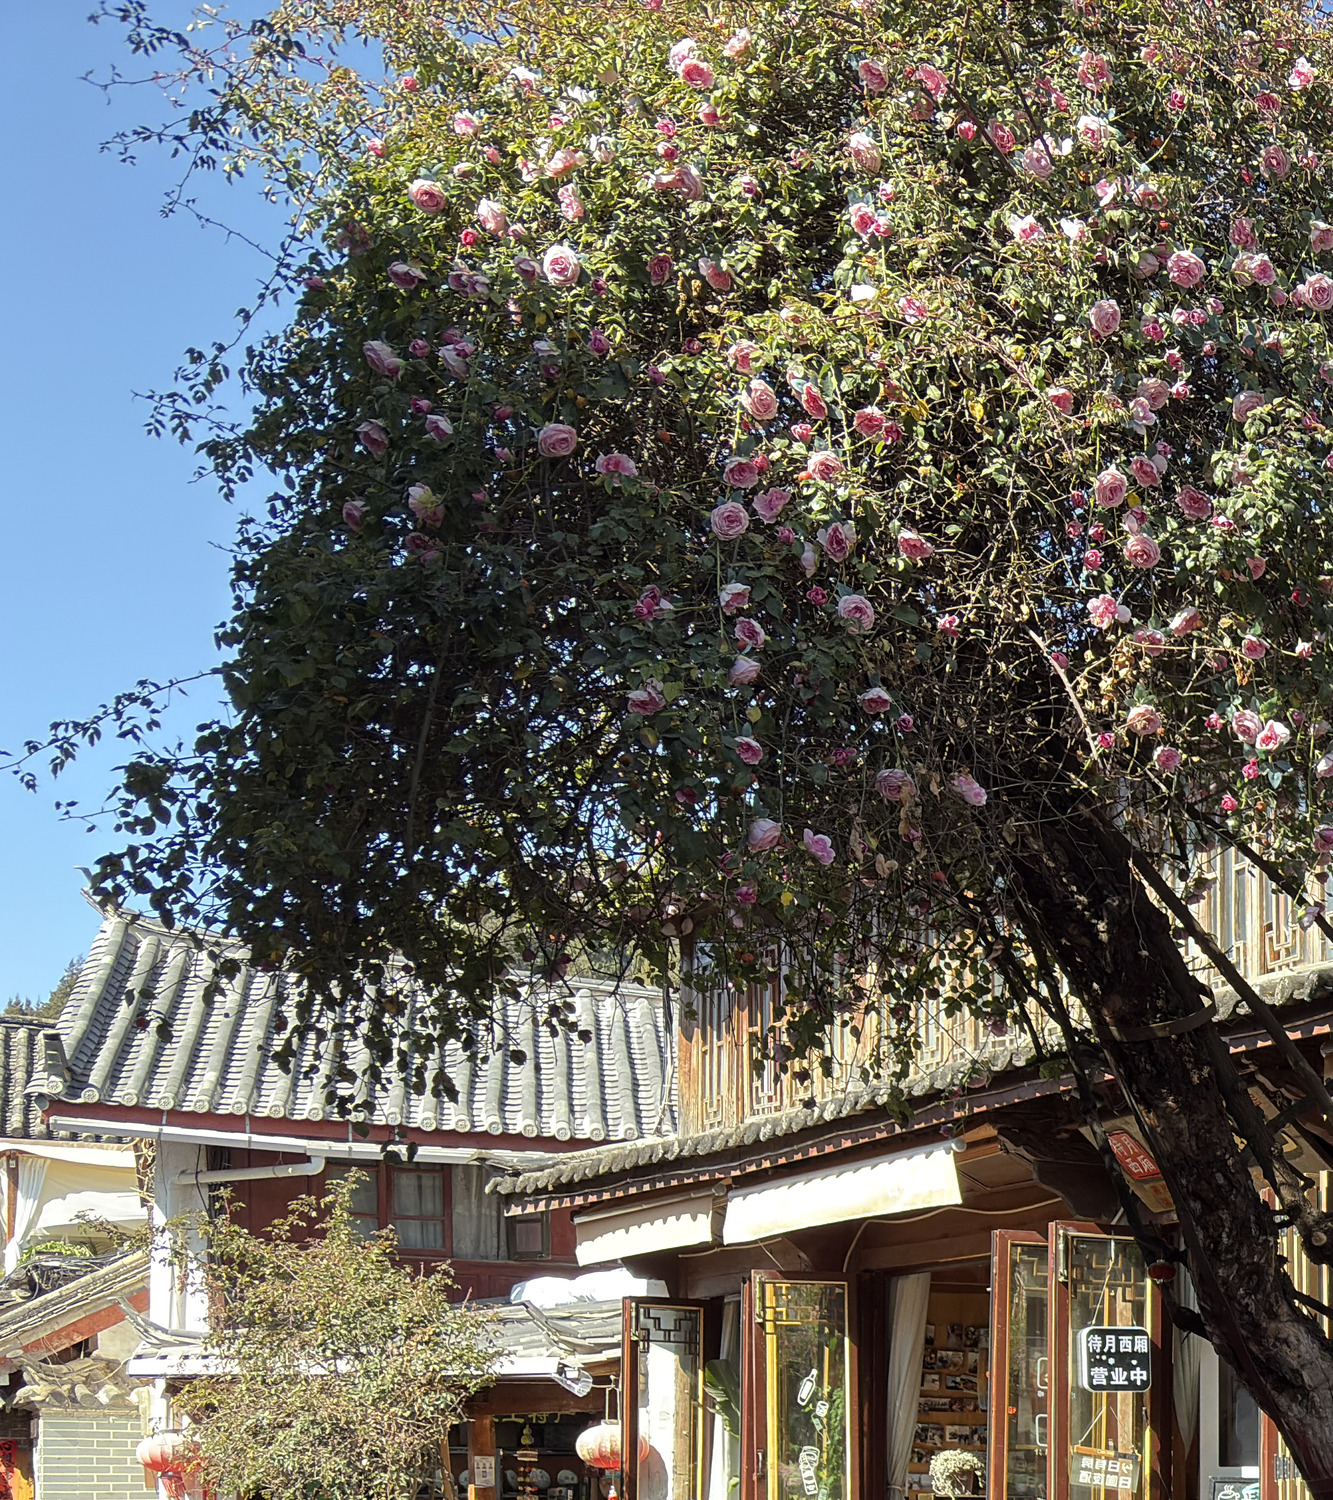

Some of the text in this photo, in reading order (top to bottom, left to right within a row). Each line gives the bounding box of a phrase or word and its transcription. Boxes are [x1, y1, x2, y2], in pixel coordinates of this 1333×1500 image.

[1087, 1334, 1148, 1353] 待月西厢
[1090, 1366, 1147, 1386] 营业中
